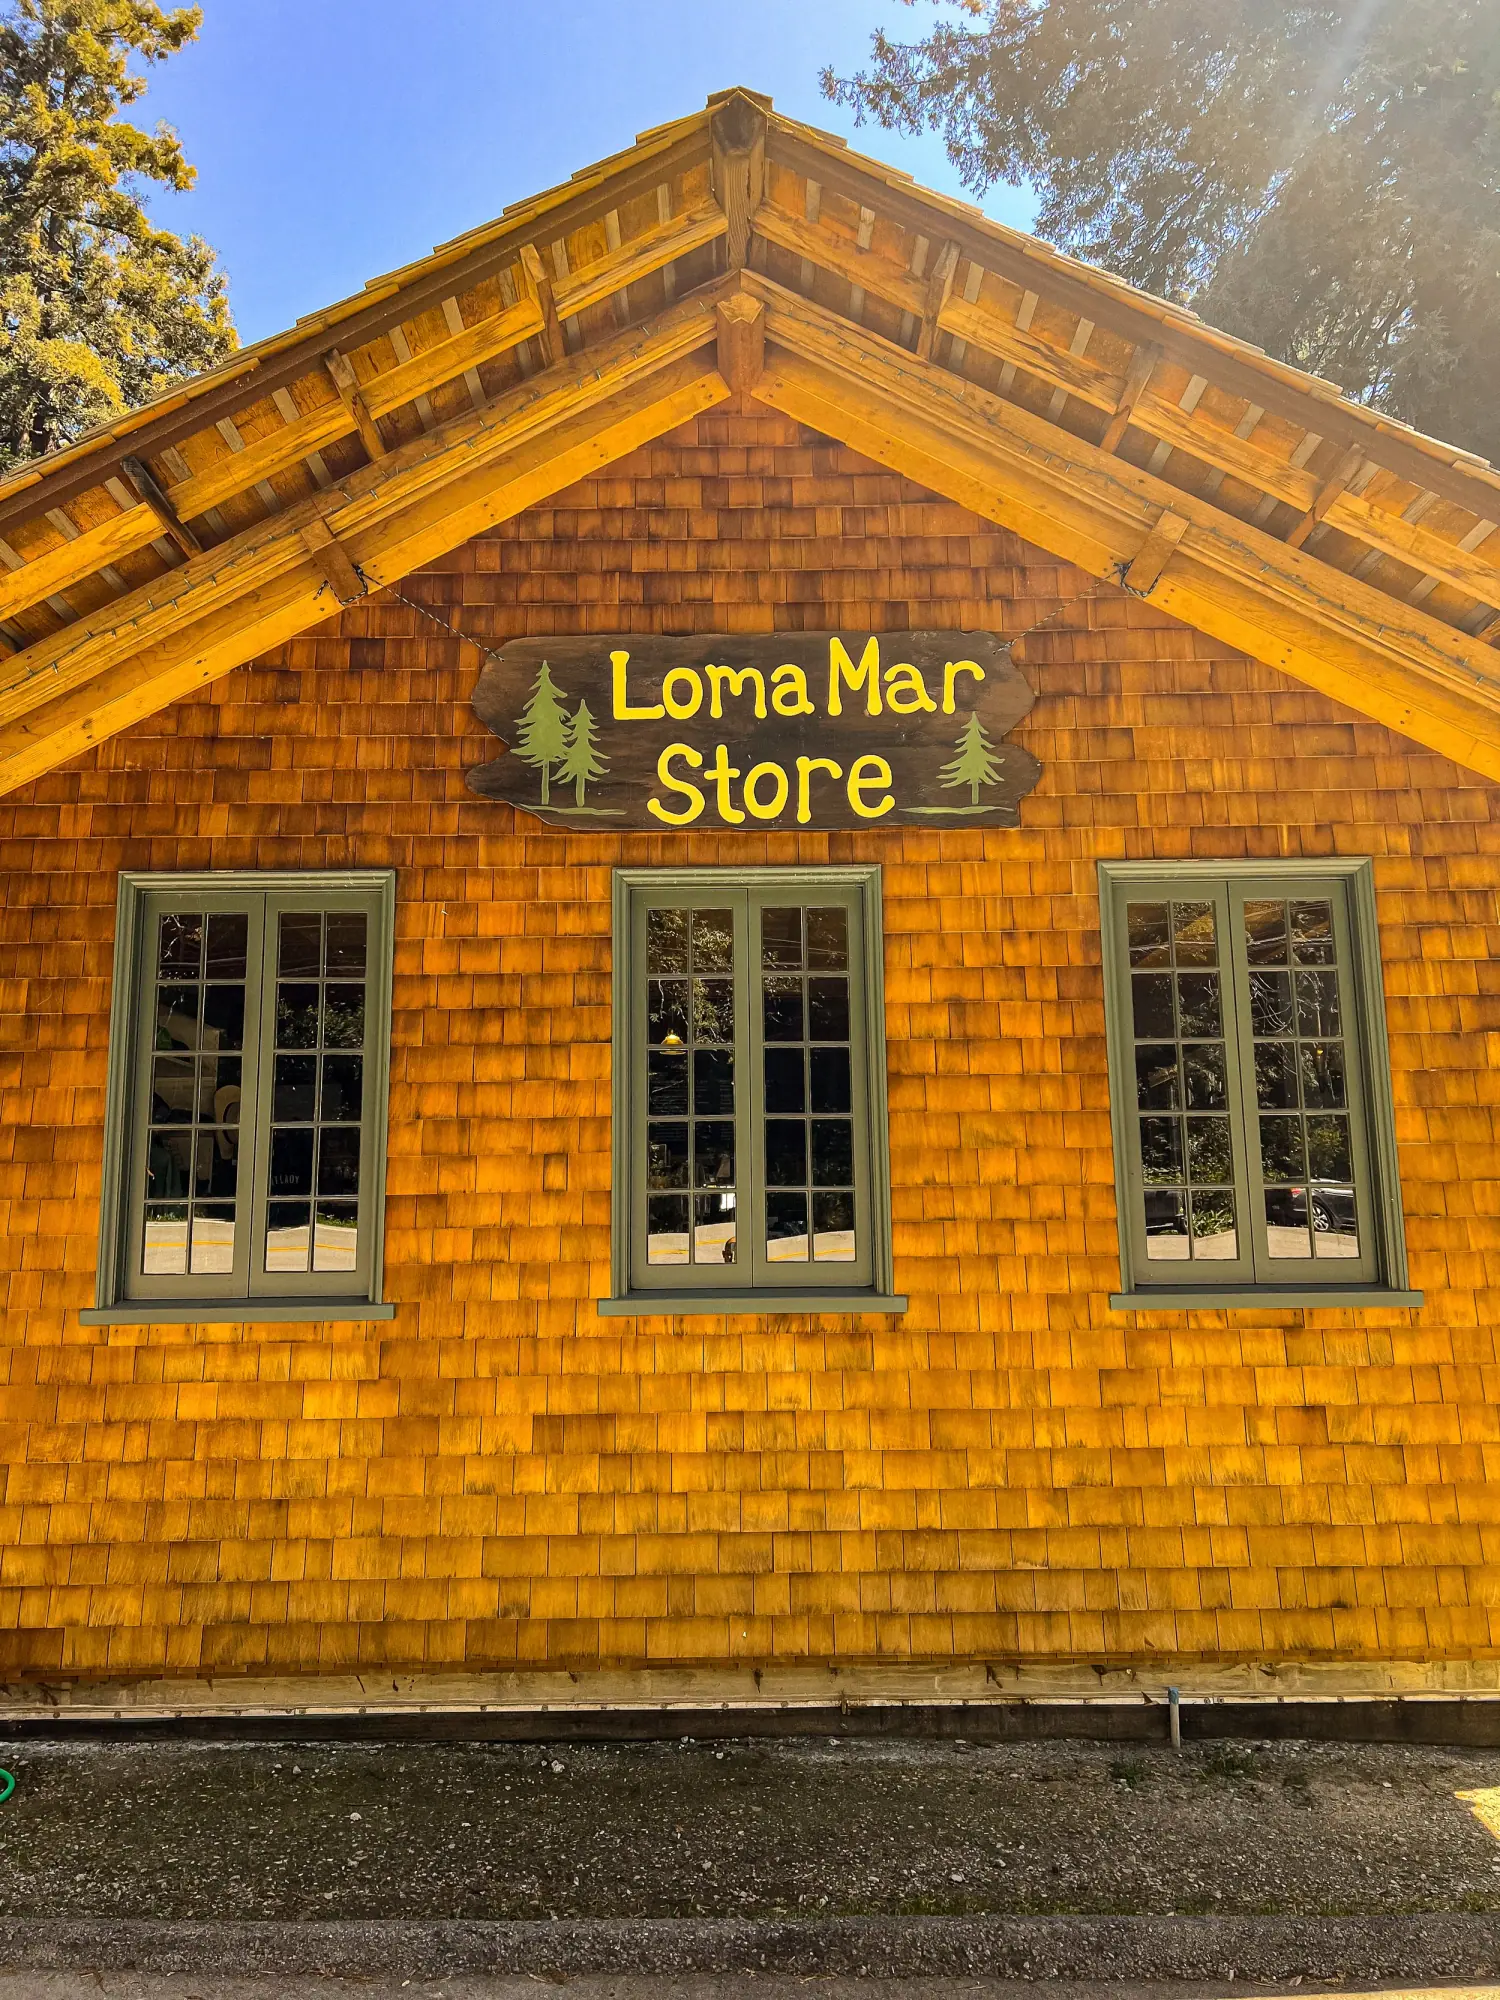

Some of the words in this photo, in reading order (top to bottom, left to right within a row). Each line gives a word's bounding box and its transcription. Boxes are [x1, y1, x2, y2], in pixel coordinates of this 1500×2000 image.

[609, 650, 814, 720] Loma
[827, 636, 986, 717] Mar
[646, 743, 896, 825] Store
